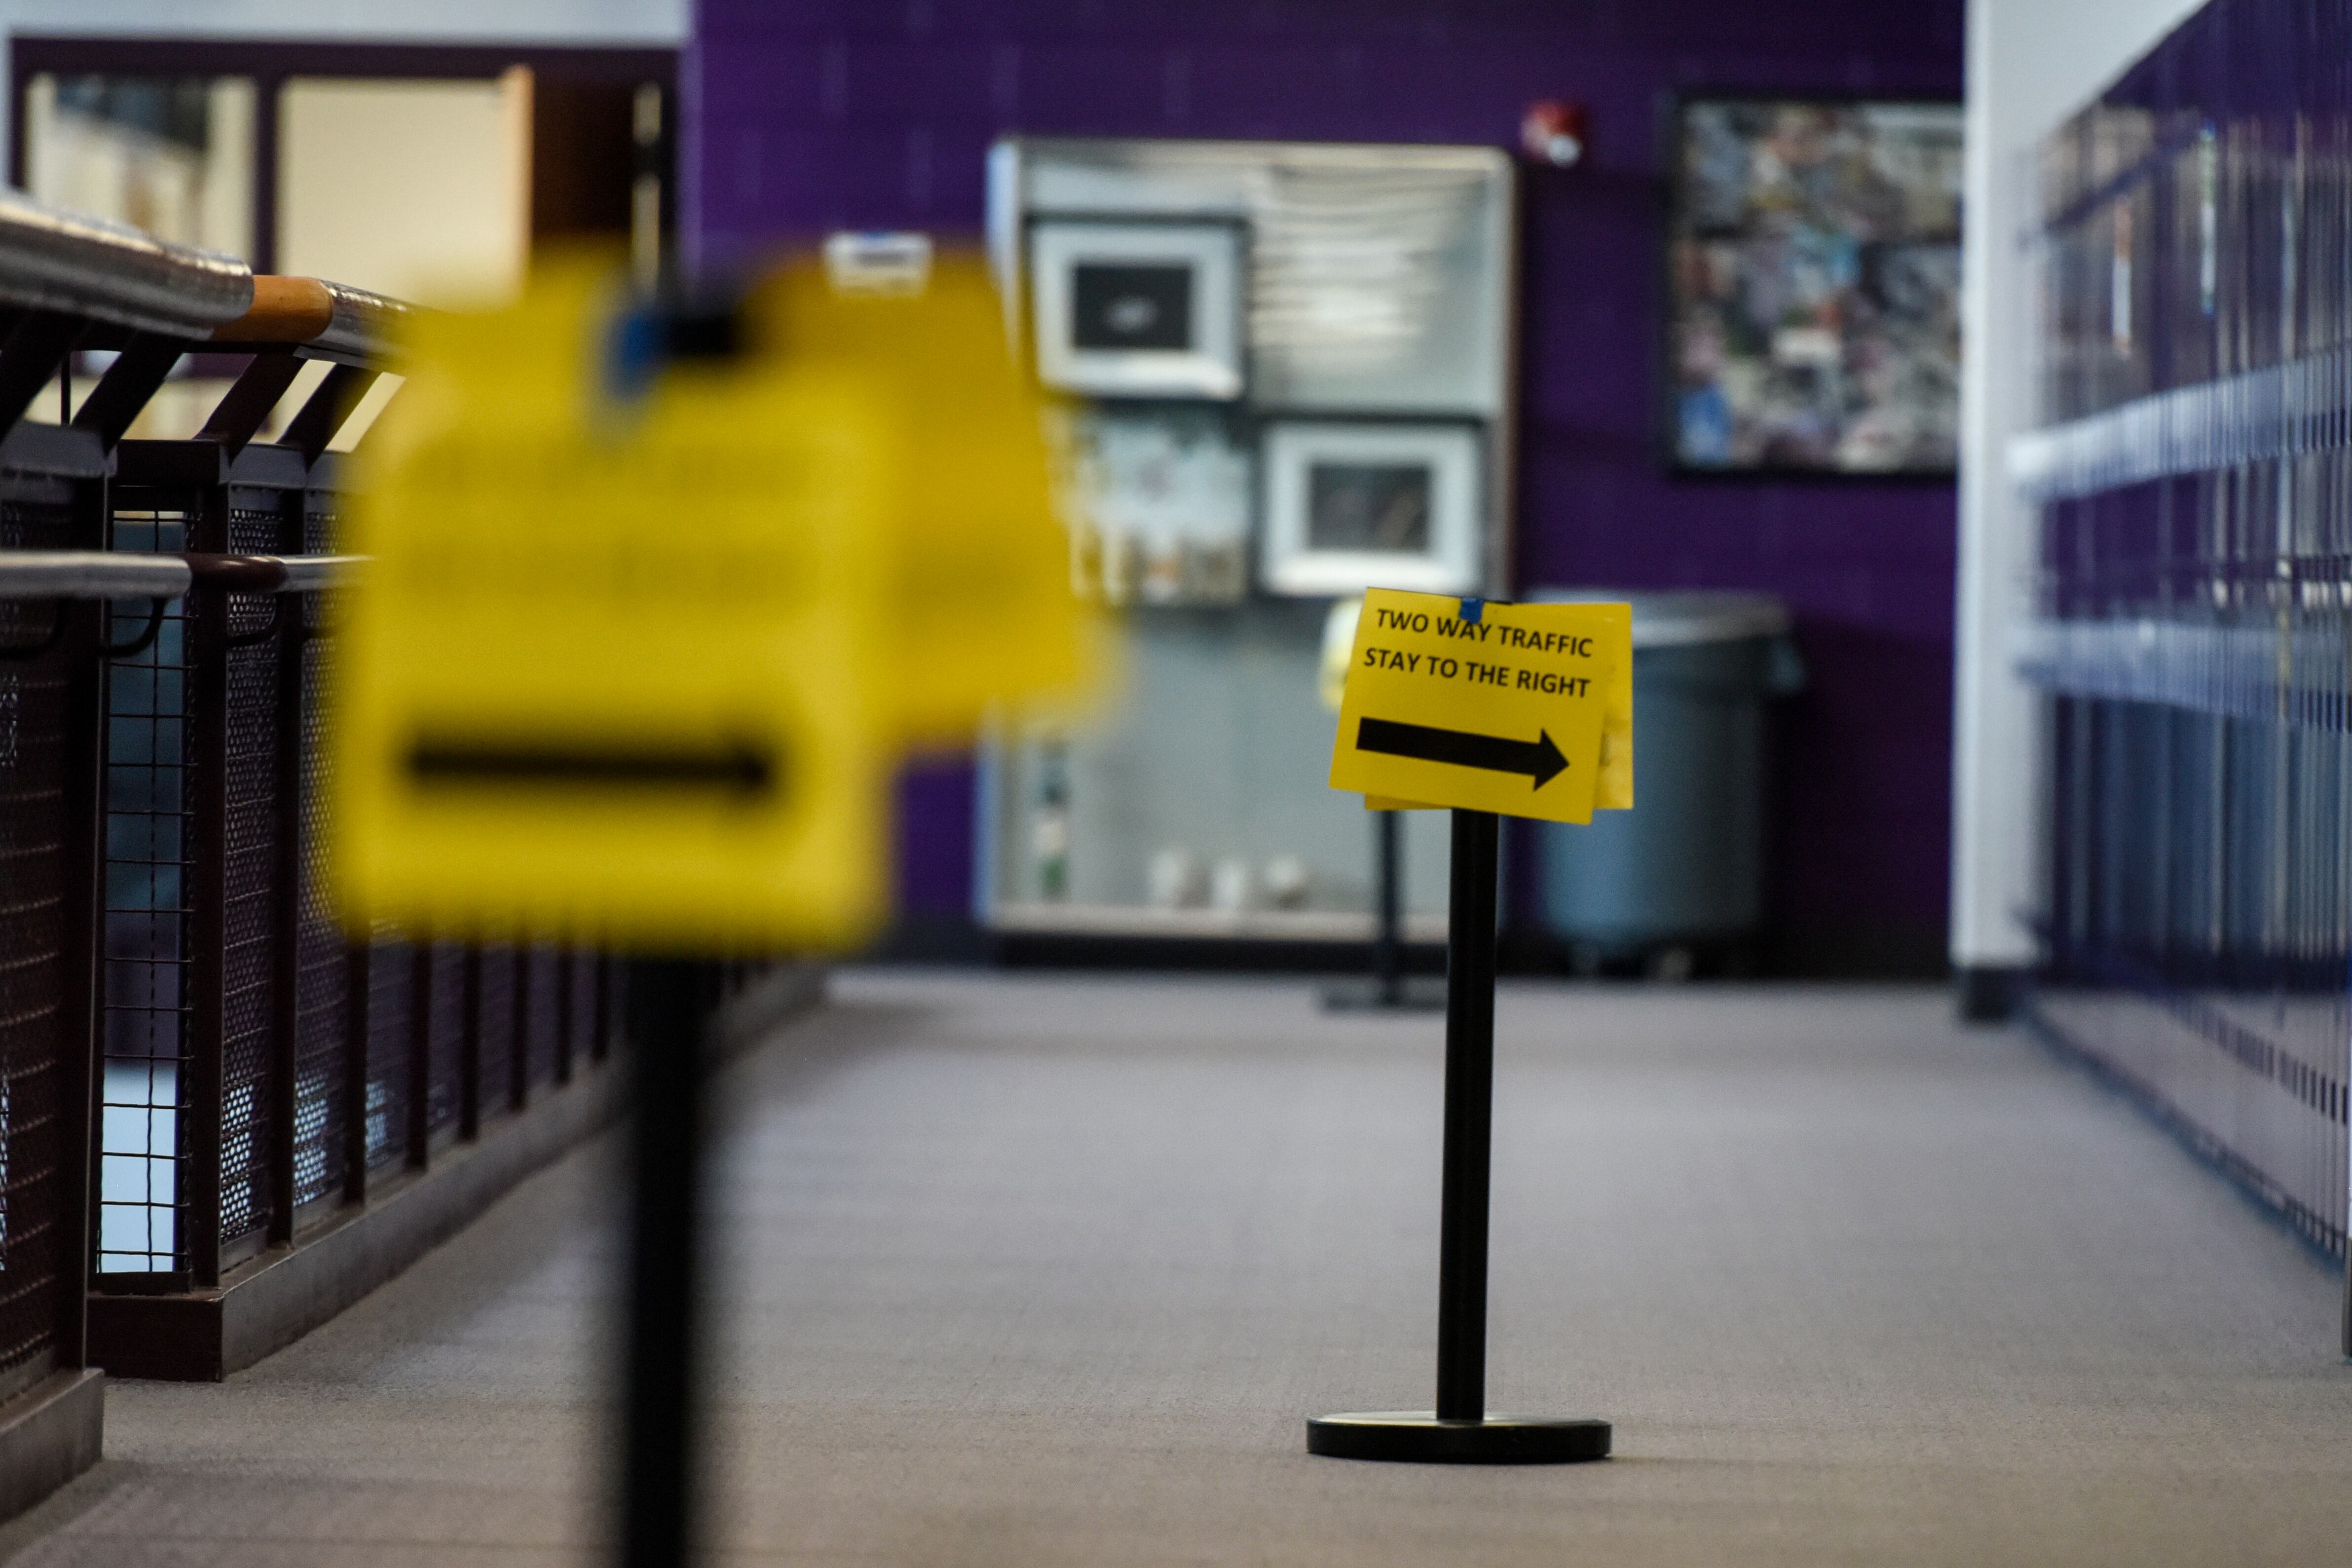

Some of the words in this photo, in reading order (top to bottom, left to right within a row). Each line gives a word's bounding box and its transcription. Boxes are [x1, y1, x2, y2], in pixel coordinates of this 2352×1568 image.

[1377, 609, 1429, 633] TWO
[1437, 618, 1492, 642] WAY
[1498, 625, 1593, 658] TRAFFIC
[1364, 647, 1420, 673] STAY
[1427, 656, 1458, 678] TO
[1466, 662, 1510, 686] THE
[1517, 670, 1591, 698] RIGHT
